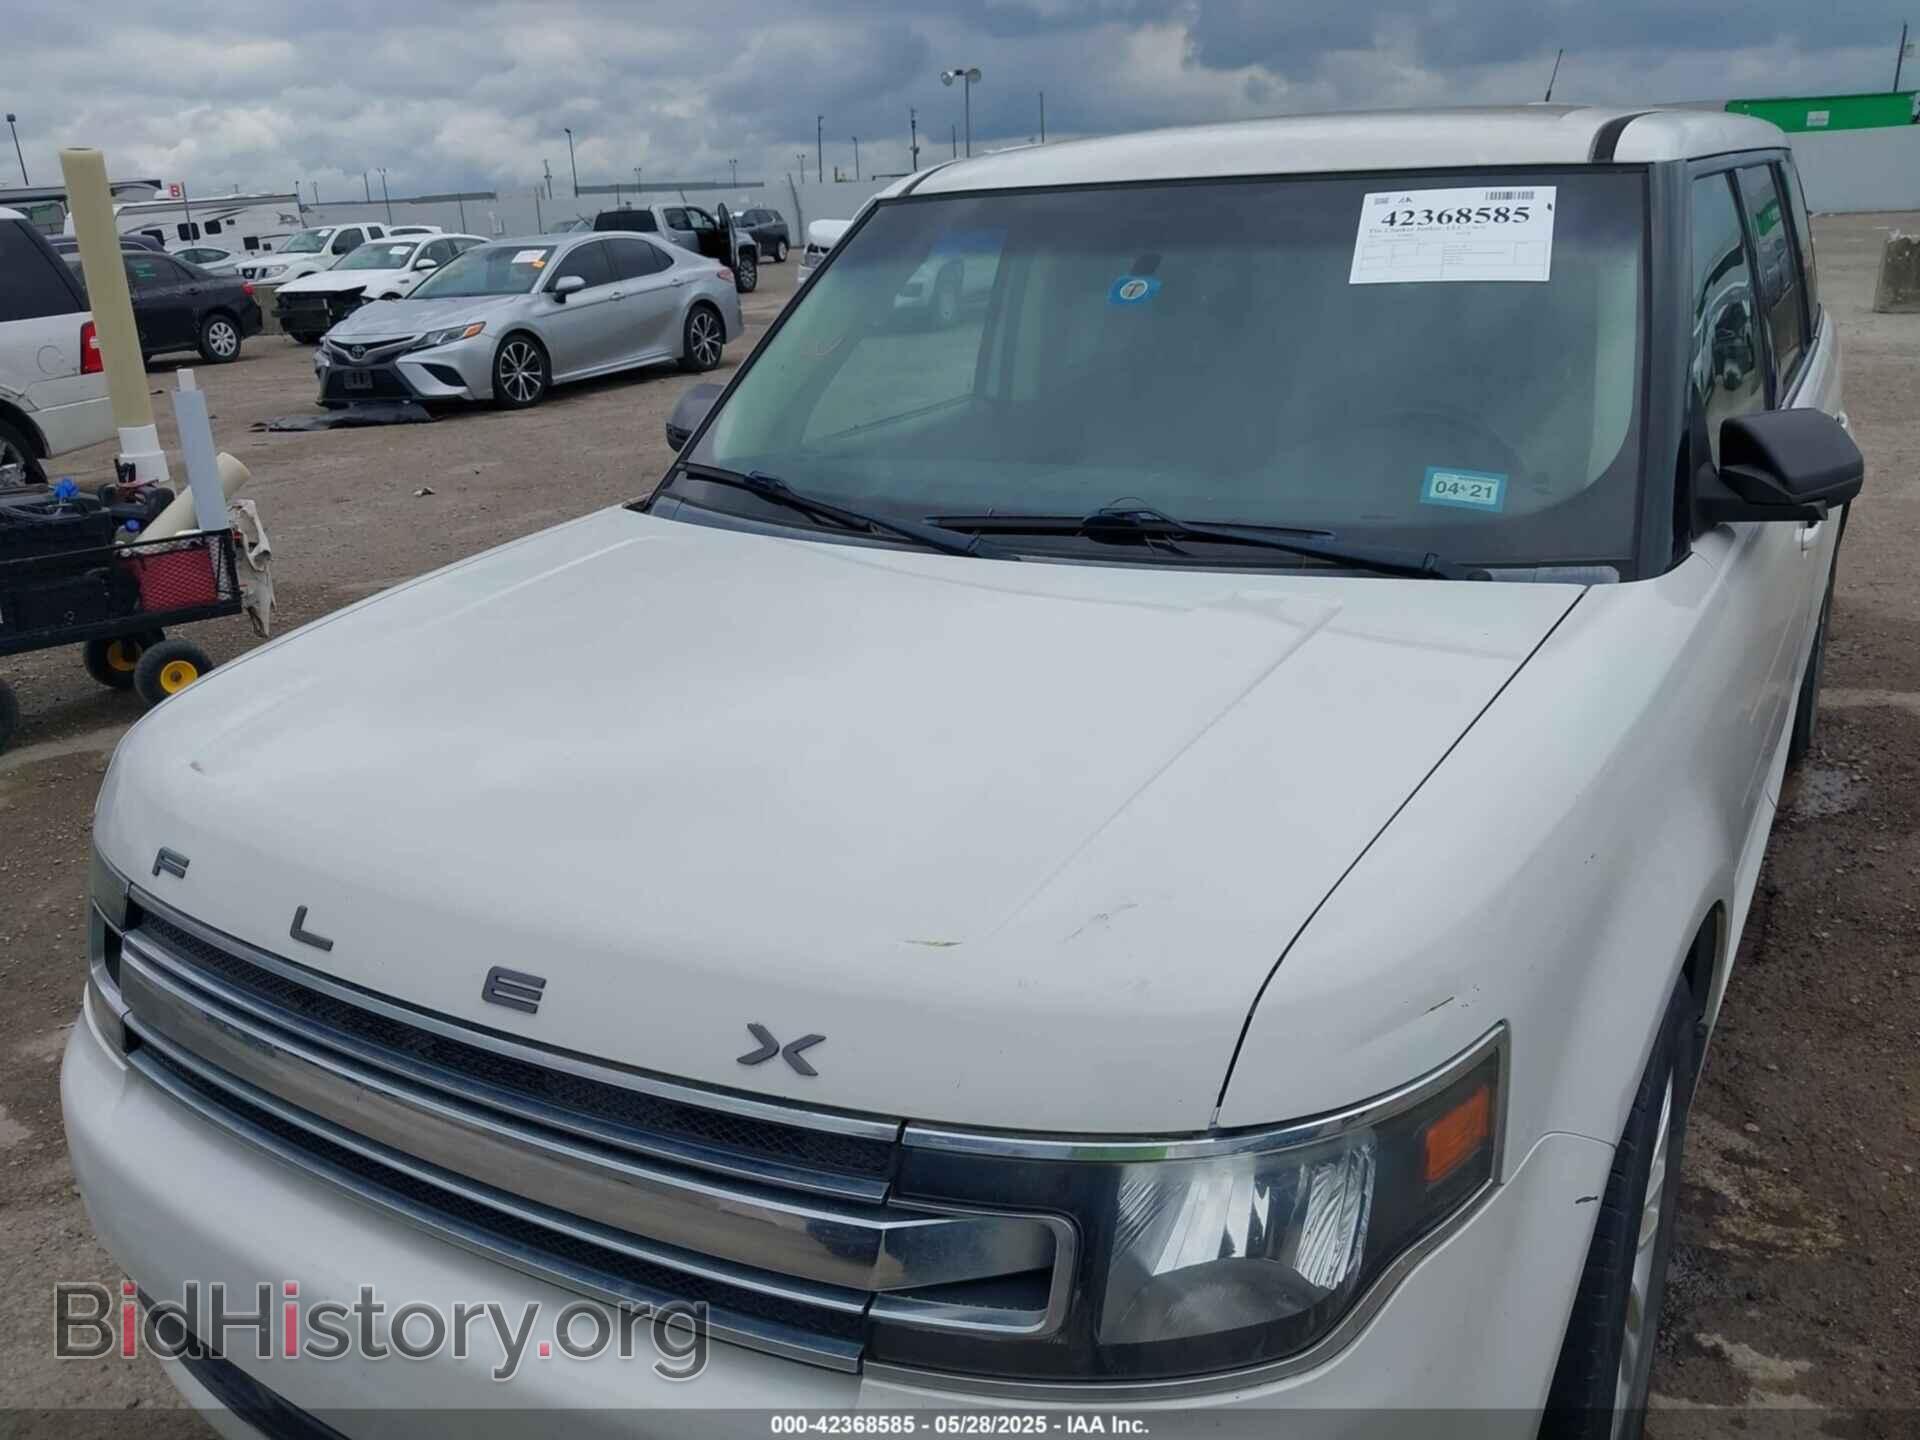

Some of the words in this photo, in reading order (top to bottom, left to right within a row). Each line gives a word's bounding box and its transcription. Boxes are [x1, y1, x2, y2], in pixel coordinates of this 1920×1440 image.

[1382, 206, 1529, 226] 42368585
[1435, 481, 1458, 495] 04
[1470, 485, 1492, 499] 21
[152, 847, 826, 1076] FLEX
